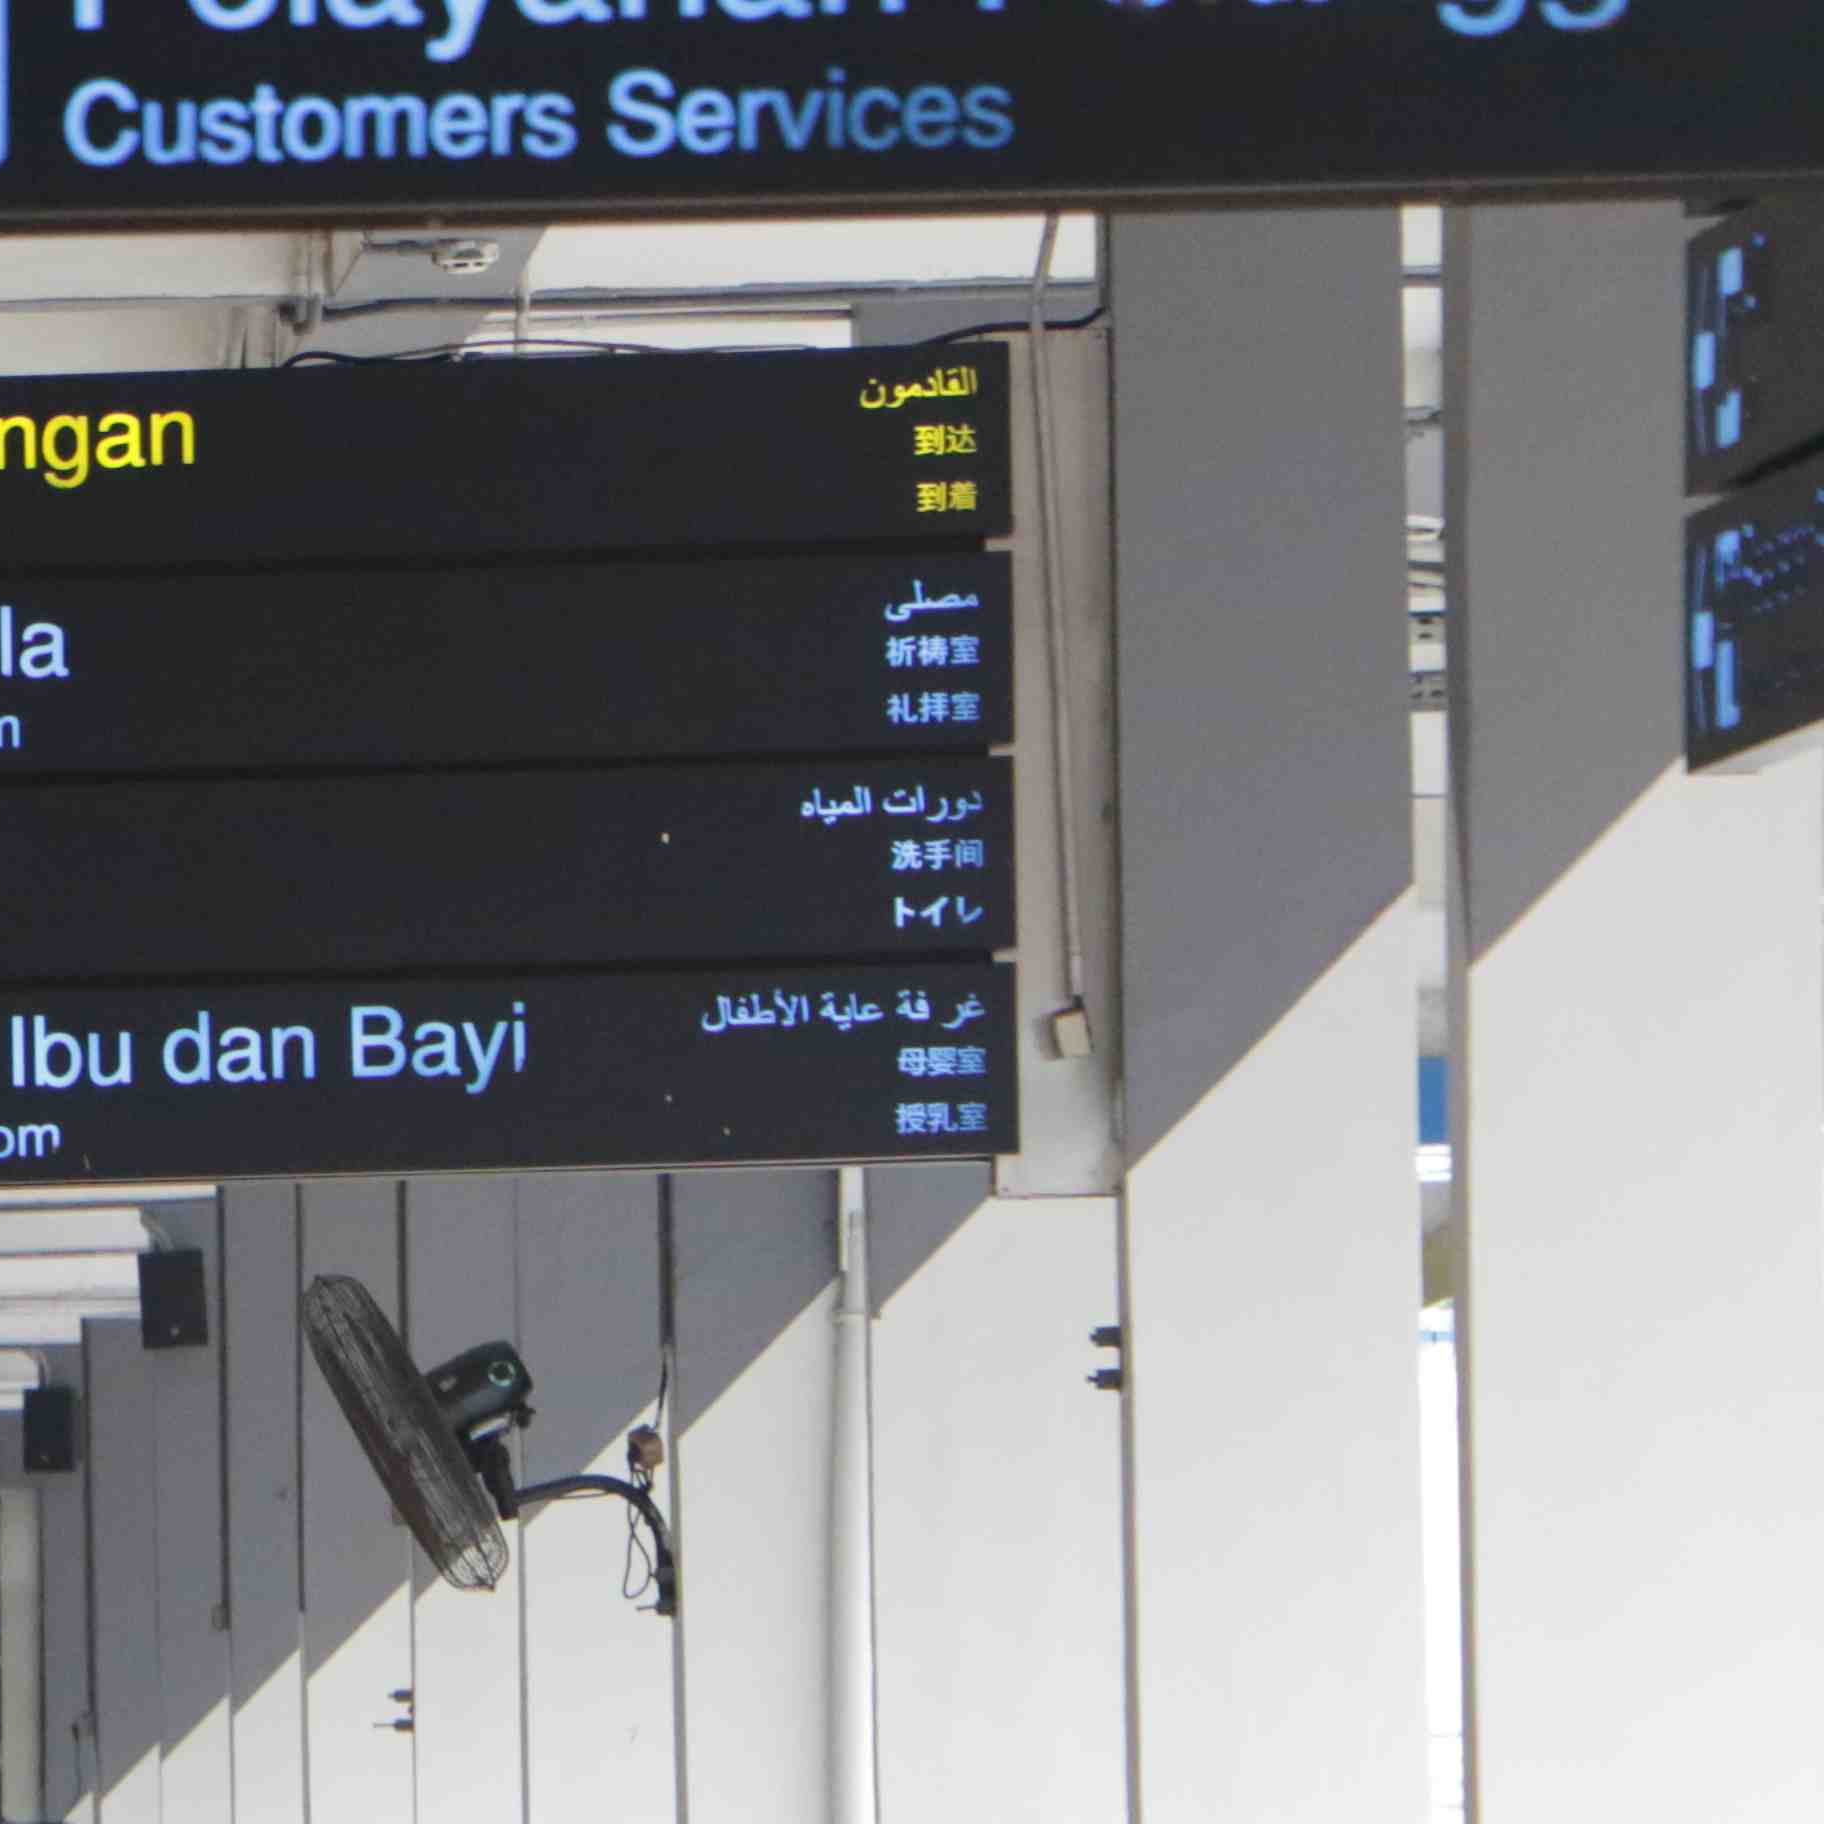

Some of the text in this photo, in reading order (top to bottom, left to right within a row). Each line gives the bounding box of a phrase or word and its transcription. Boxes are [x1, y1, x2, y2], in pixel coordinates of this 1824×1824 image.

[63, 68, 1013, 168] Customers Services
[859, 366, 977, 409] القادمون
[914, 423, 977, 456] 到达
[916, 480, 977, 513] 到着
[891, 838, 984, 872] 洗手间
[895, 895, 983, 929] トイレ
[11, 1014, 133, 1090] Ibu
[162, 1010, 317, 1086] dan
[350, 1001, 527, 1095] Bayi
